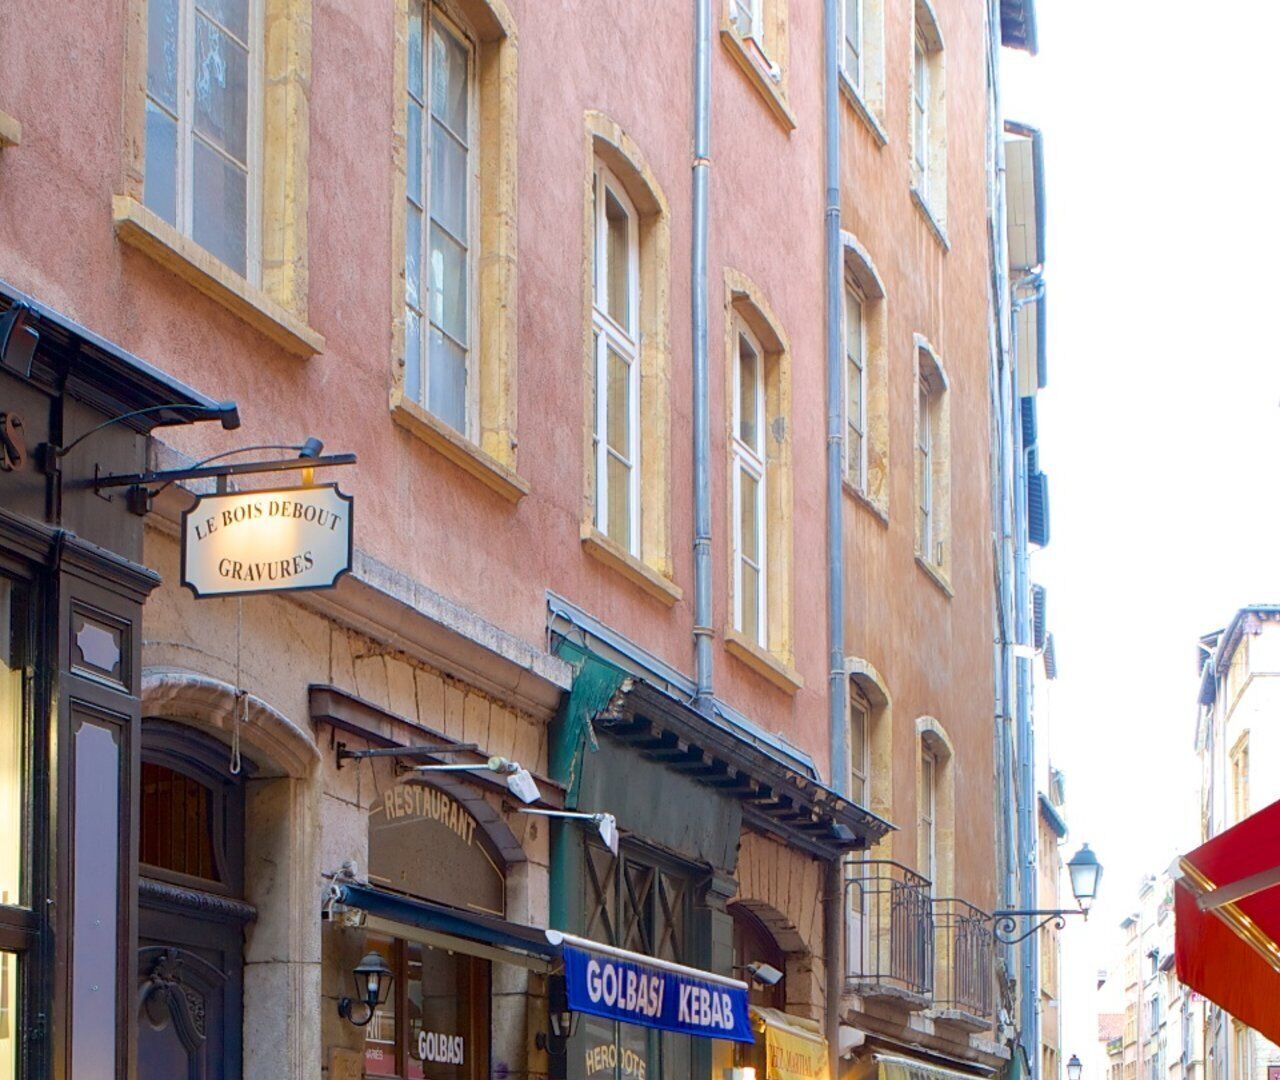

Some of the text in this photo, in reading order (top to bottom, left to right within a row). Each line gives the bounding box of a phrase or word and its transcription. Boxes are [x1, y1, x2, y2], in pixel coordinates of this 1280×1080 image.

[195, 501, 342, 541] LE BOIS DEBOUT
[219, 551, 314, 582] GRAVURES
[383, 784, 477, 846] RESTAURANT
[586, 959, 735, 1031] GOLBASI KEBAB
[418, 1030, 464, 1065] GOLBASI
